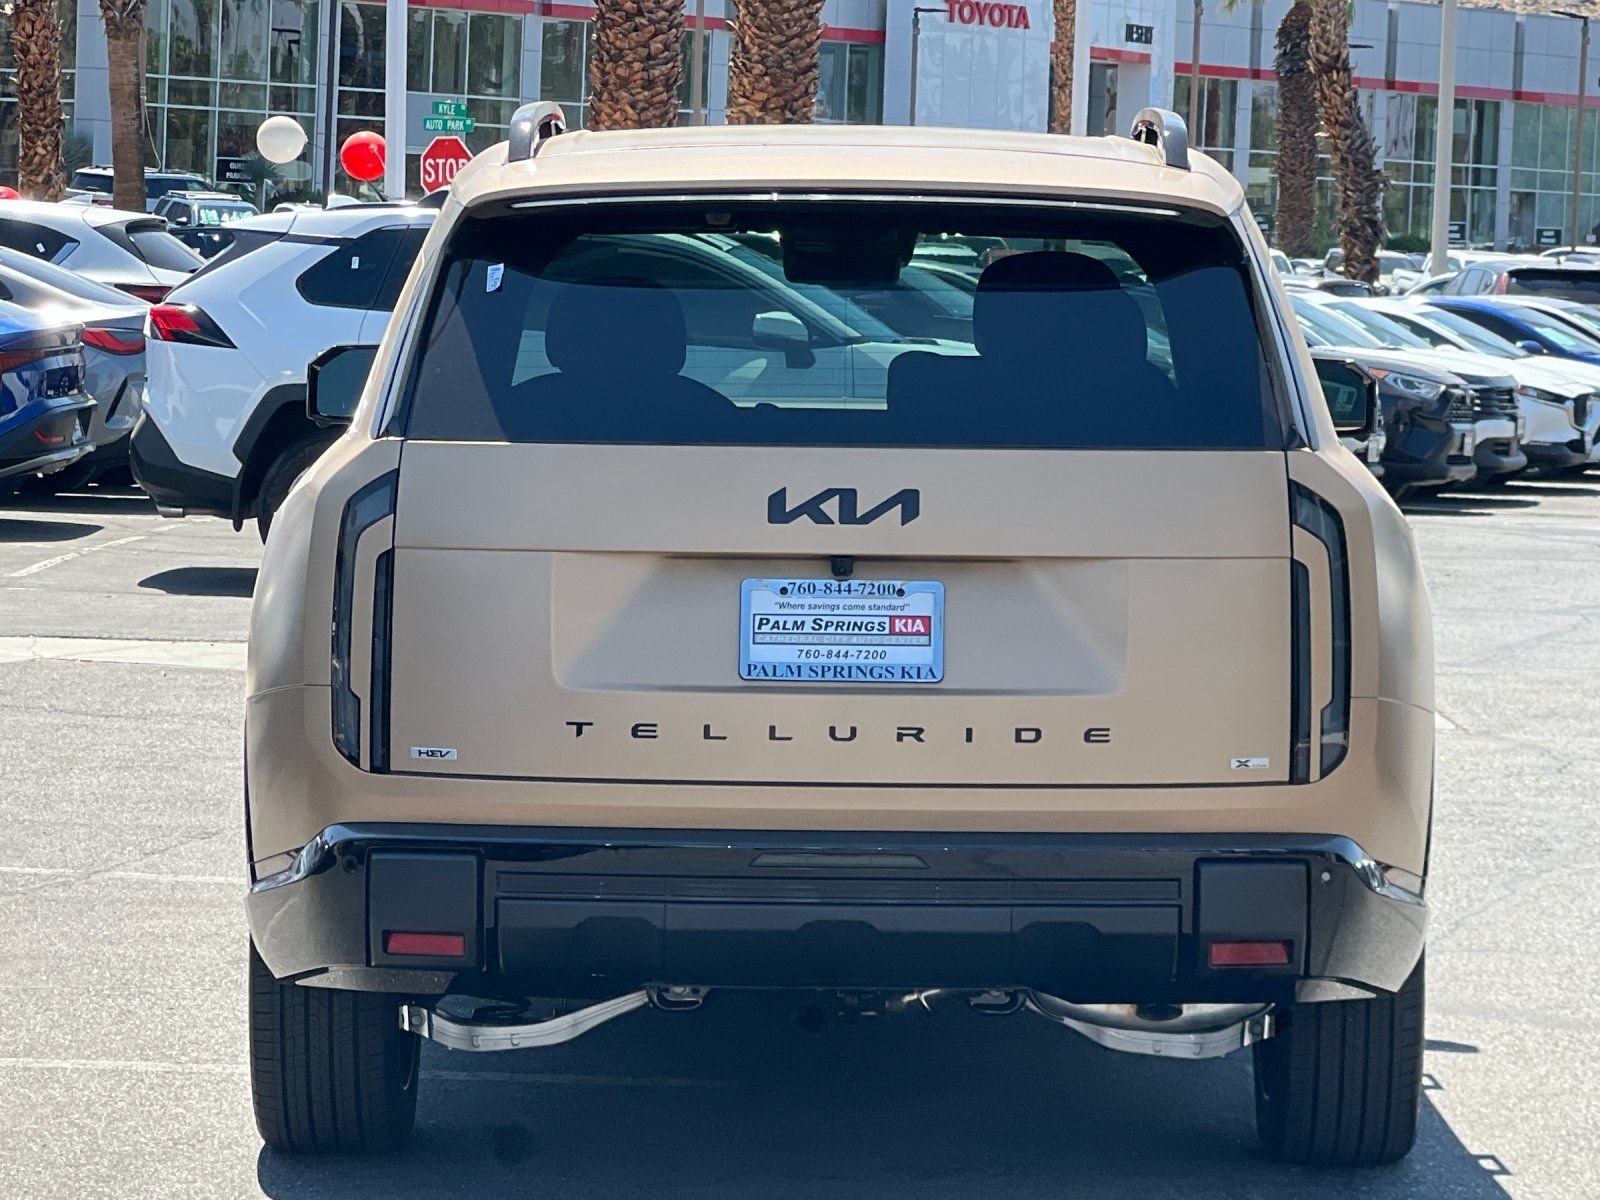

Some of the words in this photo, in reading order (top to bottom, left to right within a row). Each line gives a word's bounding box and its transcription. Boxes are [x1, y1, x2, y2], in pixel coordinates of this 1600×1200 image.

[945, 0, 1030, 29] TOYOTA
[438, 103, 456, 115] KYLE
[425, 119, 443, 131] AUTO
[447, 119, 464, 131] PARK
[787, 582, 896, 596] 760-844-7200
[774, 602, 805, 611] "Where
[807, 603, 840, 612] savings
[868, 603, 910, 612] standard"
[757, 617, 805, 631] PALM
[811, 617, 887, 633] SPRINGS
[894, 619, 925, 633] KIA
[756, 633, 818, 643] CATHEDRAL
[823, 634, 850, 644] CITY
[850, 635, 880, 645] AUTO
[883, 635, 930, 645] CENTER
[797, 649, 887, 661] 760-844-7200
[746, 663, 802, 678] PALM
[808, 664, 896, 680] SPRINGS
[900, 665, 938, 680] KIA
[565, 721, 1112, 743] TELLURIDE
[418, 749, 451, 758] HEV
